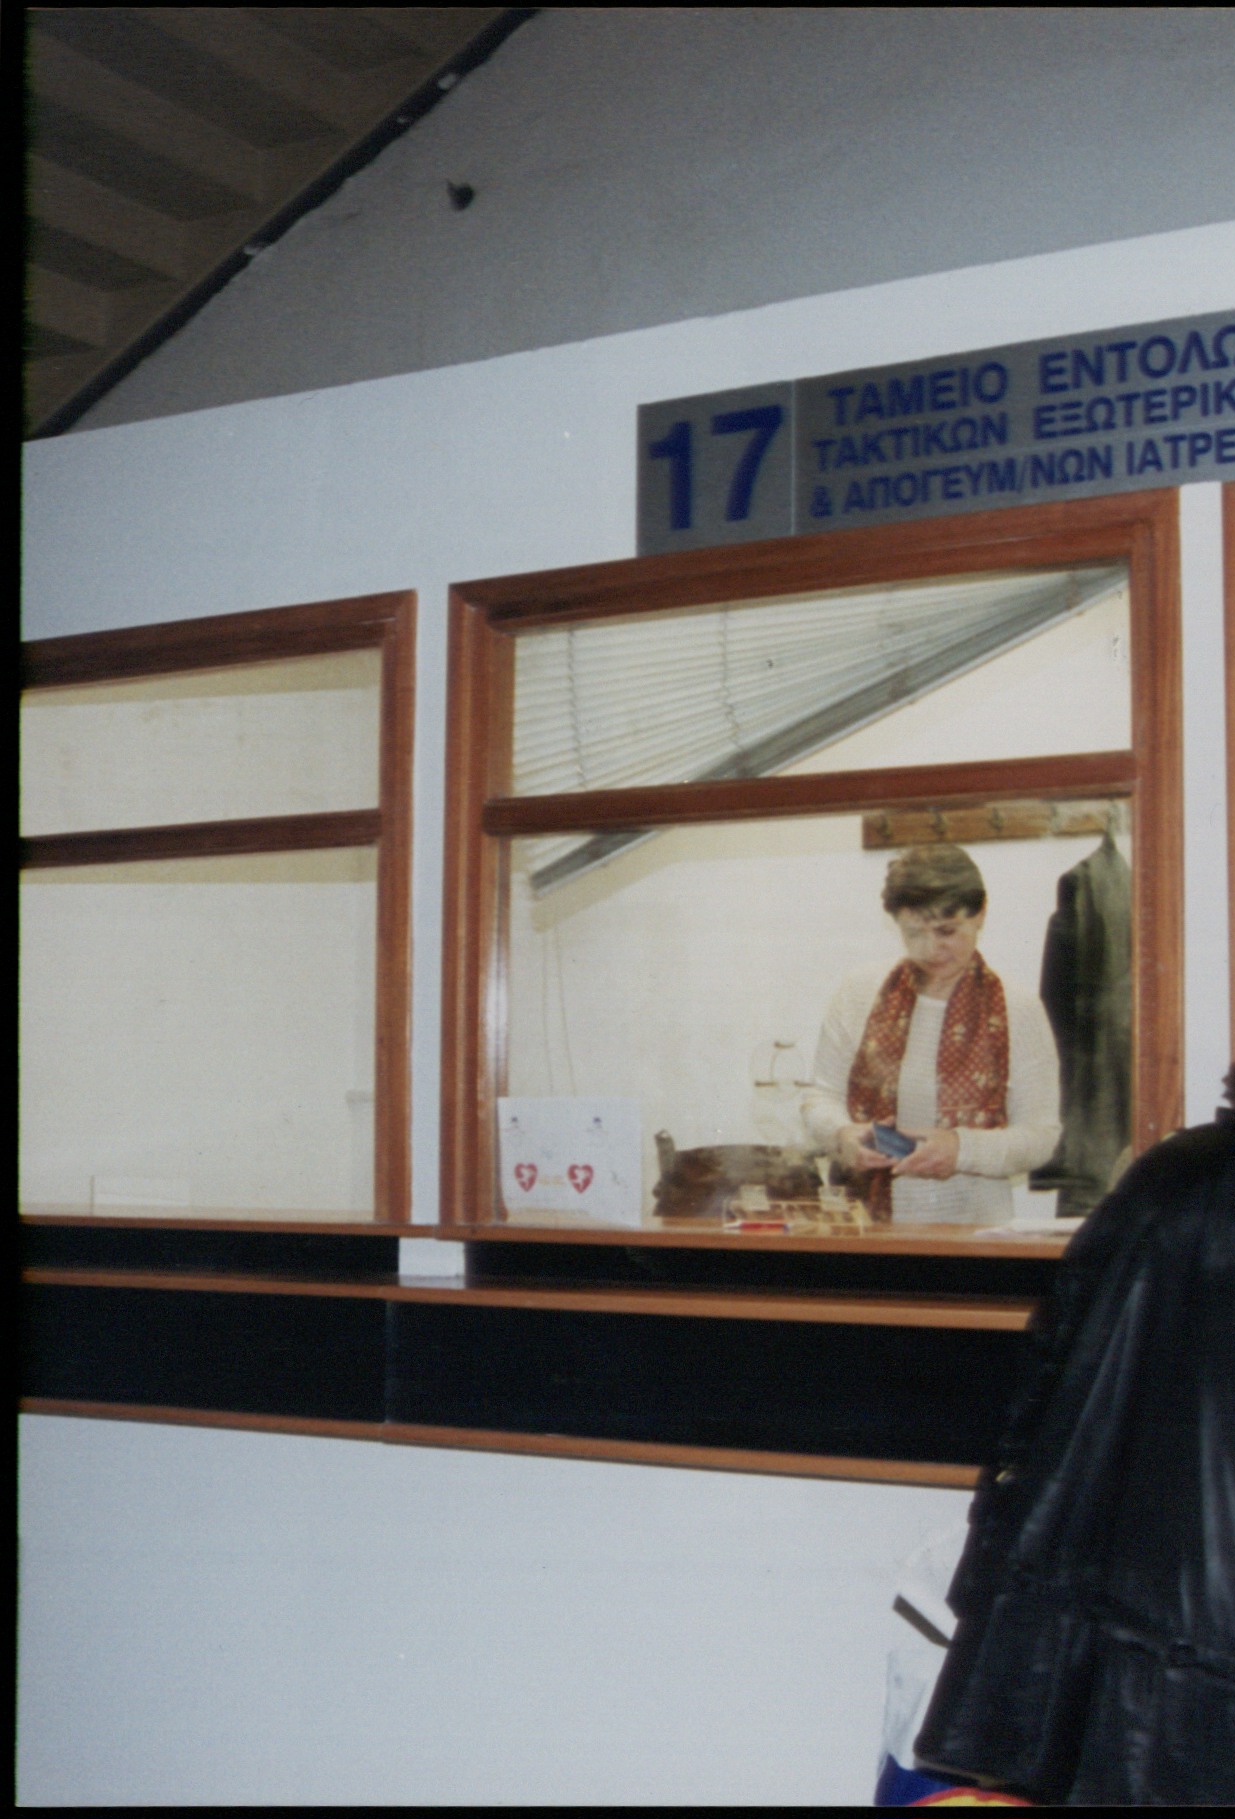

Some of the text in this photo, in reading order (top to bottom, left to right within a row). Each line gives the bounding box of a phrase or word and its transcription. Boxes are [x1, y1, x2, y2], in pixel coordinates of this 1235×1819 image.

[827, 361, 1009, 427] ΤΑΜΕΙΟ
[648, 404, 784, 531] 17
[811, 411, 1009, 472] ΤΑΚΤΙΚΩΝ
[809, 485, 832, 519] &
[841, 444, 1113, 514] ΑΠΟΓΕΥΜ/ΝΩΝ
